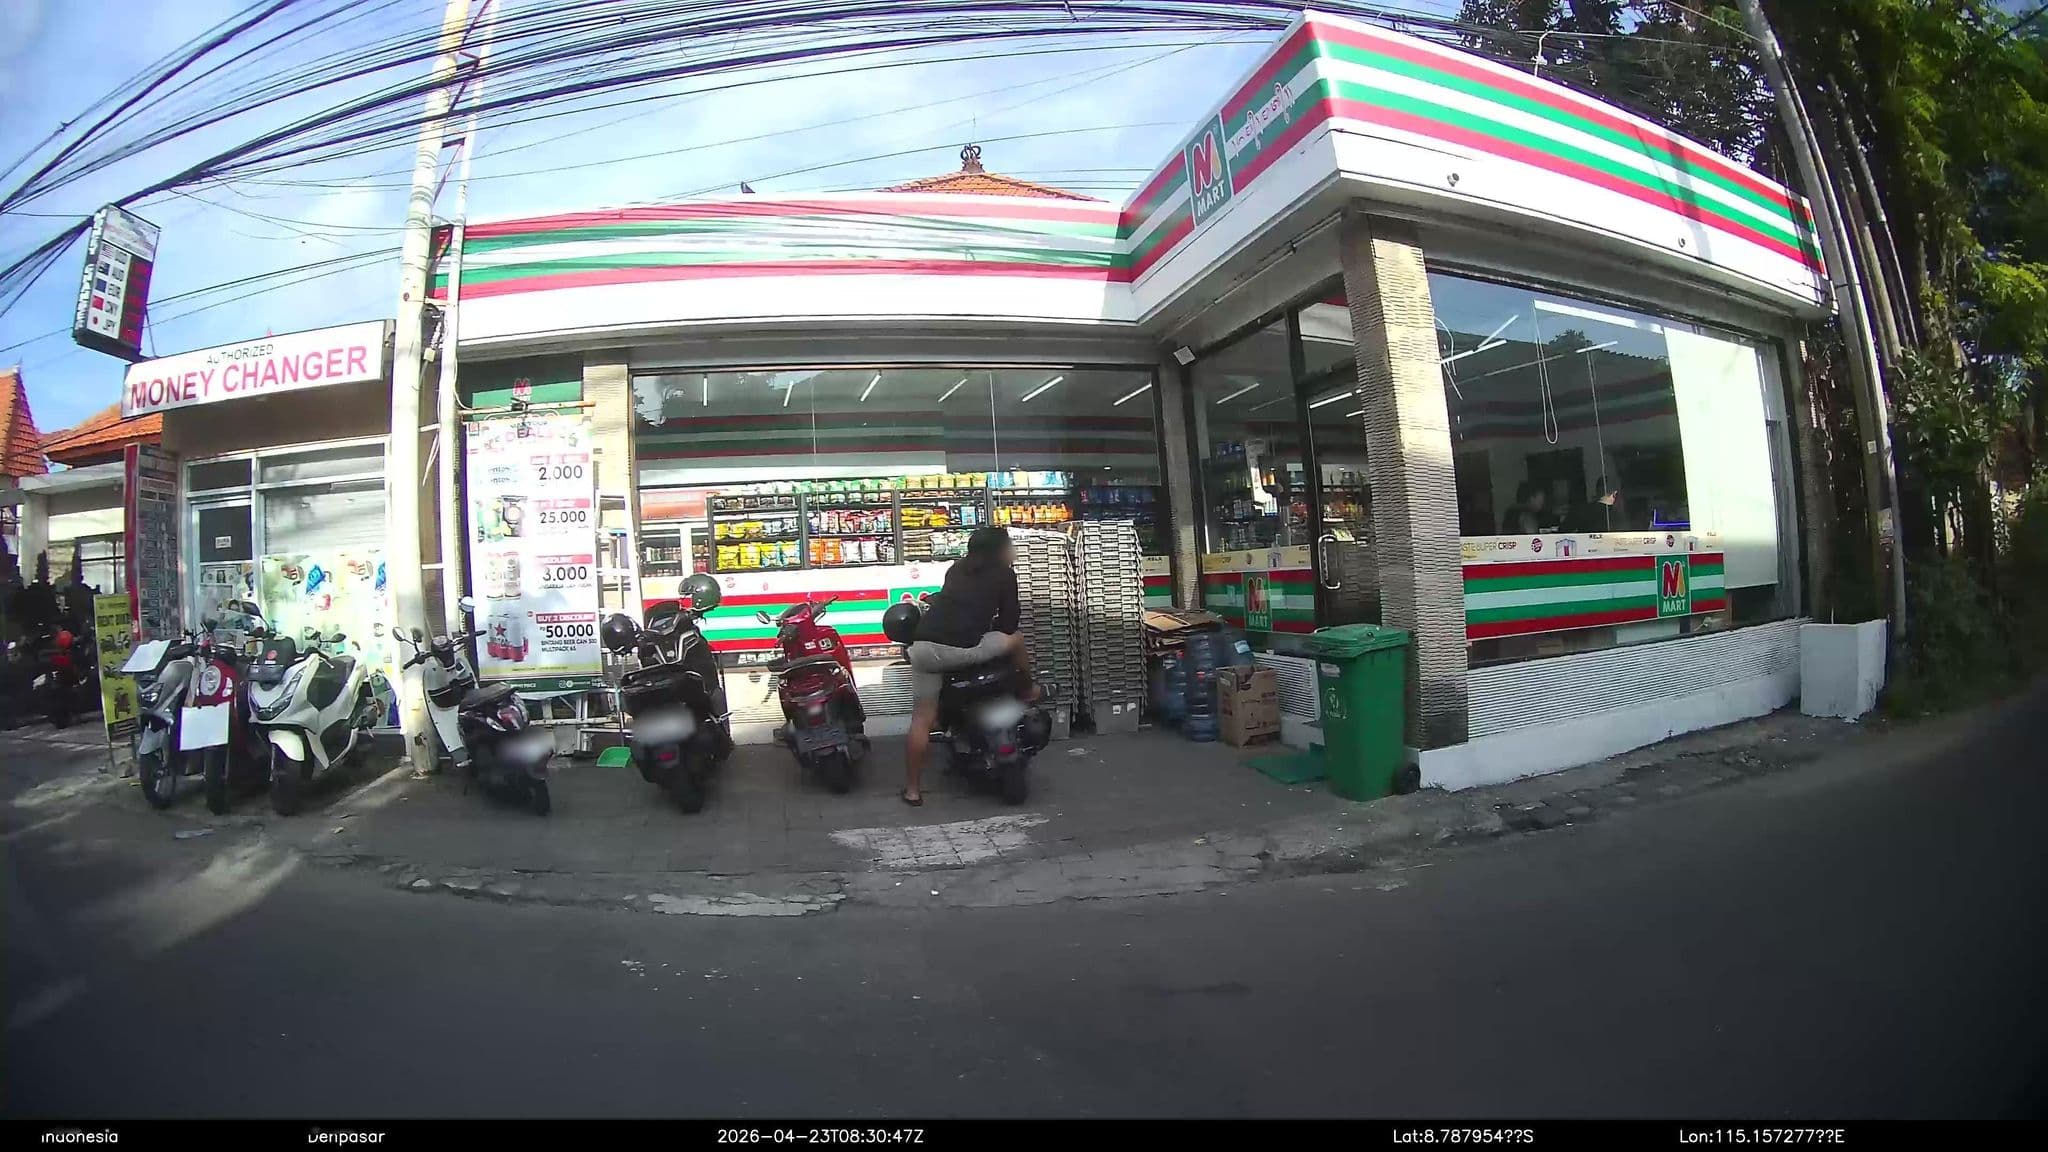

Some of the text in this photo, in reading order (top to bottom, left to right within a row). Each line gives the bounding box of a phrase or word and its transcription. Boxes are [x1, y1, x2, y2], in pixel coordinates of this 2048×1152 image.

[1197, 179, 1225, 217] MART
[206, 344, 274, 365] AUTHORIZED
[130, 345, 368, 410] MONEY CHANGER
[538, 465, 583, 481] 2.000
[540, 510, 586, 524] 25.000
[1497, 541, 1517, 550] CRISP
[542, 566, 588, 582] 3.000
[1663, 600, 1687, 613] MART
[546, 624, 594, 639] 50.000
